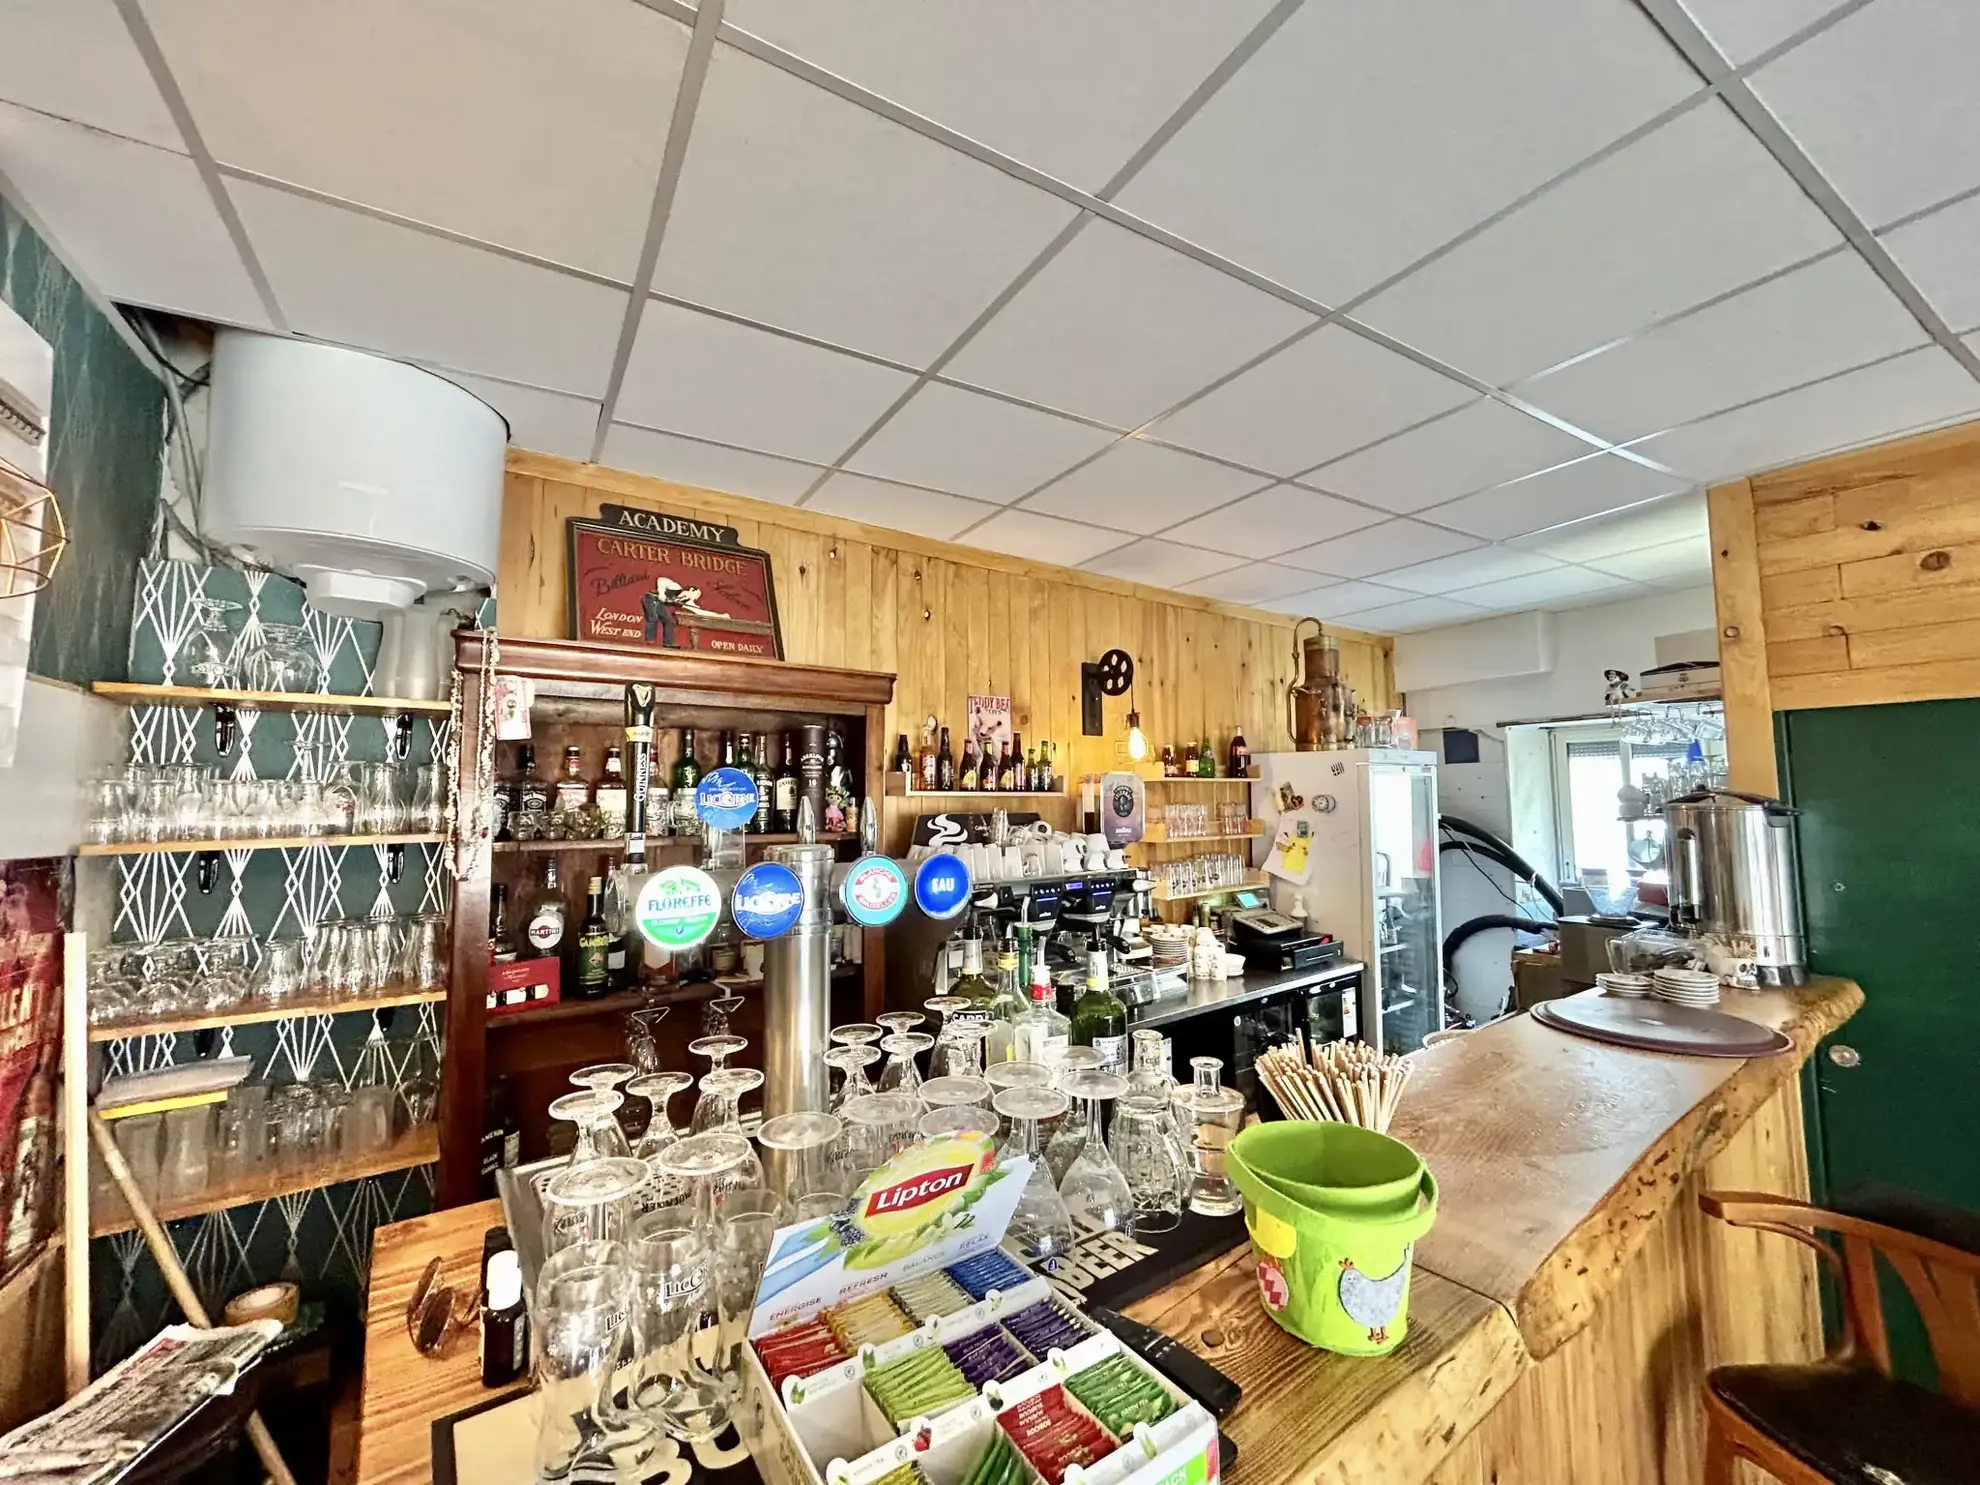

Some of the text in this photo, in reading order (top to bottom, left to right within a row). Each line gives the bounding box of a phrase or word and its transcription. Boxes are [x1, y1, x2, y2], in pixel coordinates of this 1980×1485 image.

[619, 510, 726, 542] ACADEMY
[597, 538, 748, 576] CARTER BRIDGE
[596, 607, 644, 624] LONDON
[590, 620, 643, 639] WEST END
[711, 641, 764, 654] OPEN DAILY
[969, 695, 994, 714] TEDDY
[633, 753, 649, 802] GUINNESS
[931, 877, 955, 894] EAU
[648, 894, 712, 911] FLOREFFE
[530, 927, 560, 936] MARTINI
[876, 1172, 963, 1210] Lipton
[902, 1250, 946, 1272] BALANCE
[838, 1272, 889, 1295] REFRESH
[769, 1296, 822, 1321] ENERGISE
